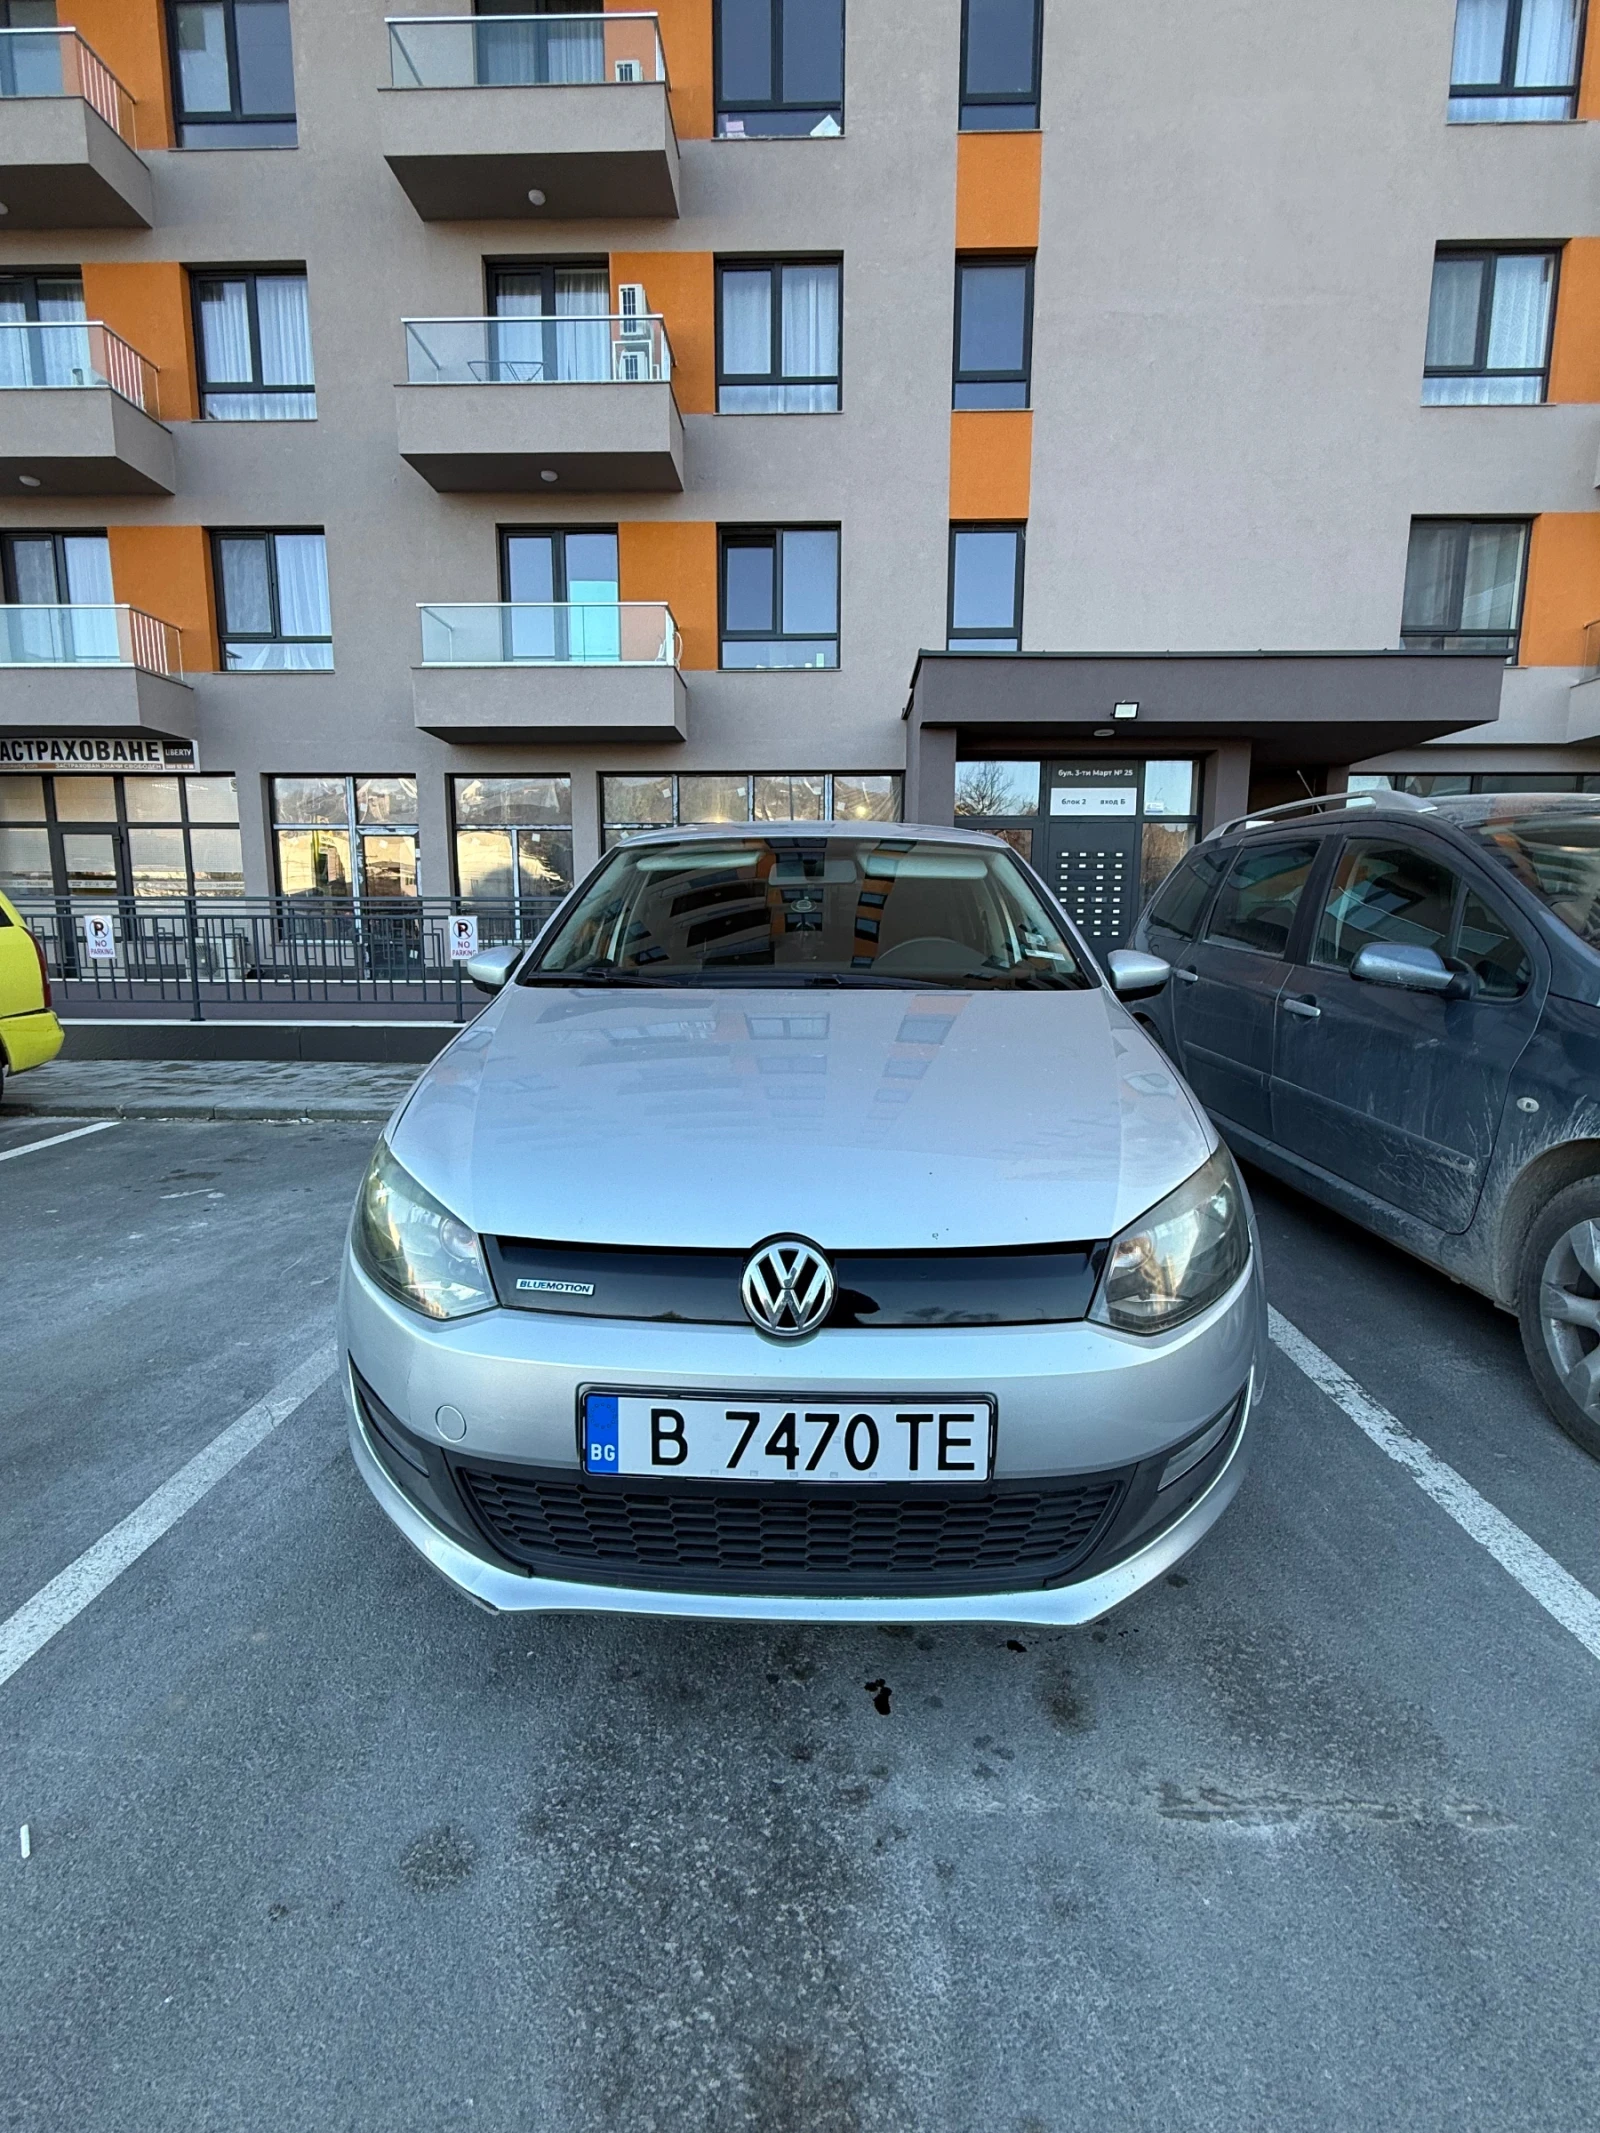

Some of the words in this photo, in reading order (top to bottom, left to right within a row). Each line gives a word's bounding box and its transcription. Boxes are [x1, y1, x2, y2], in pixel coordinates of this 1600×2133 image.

[165, 748, 191, 756] LIBERTY
[1058, 769, 1073, 777] бул.
[1092, 769, 1112, 777] Март
[519, 1280, 591, 1293] BLUEMOTION
[650, 1408, 688, 1466] B
[725, 1410, 880, 1471] 7470
[895, 1413, 975, 1471] TE
[590, 1444, 616, 1462] BG
